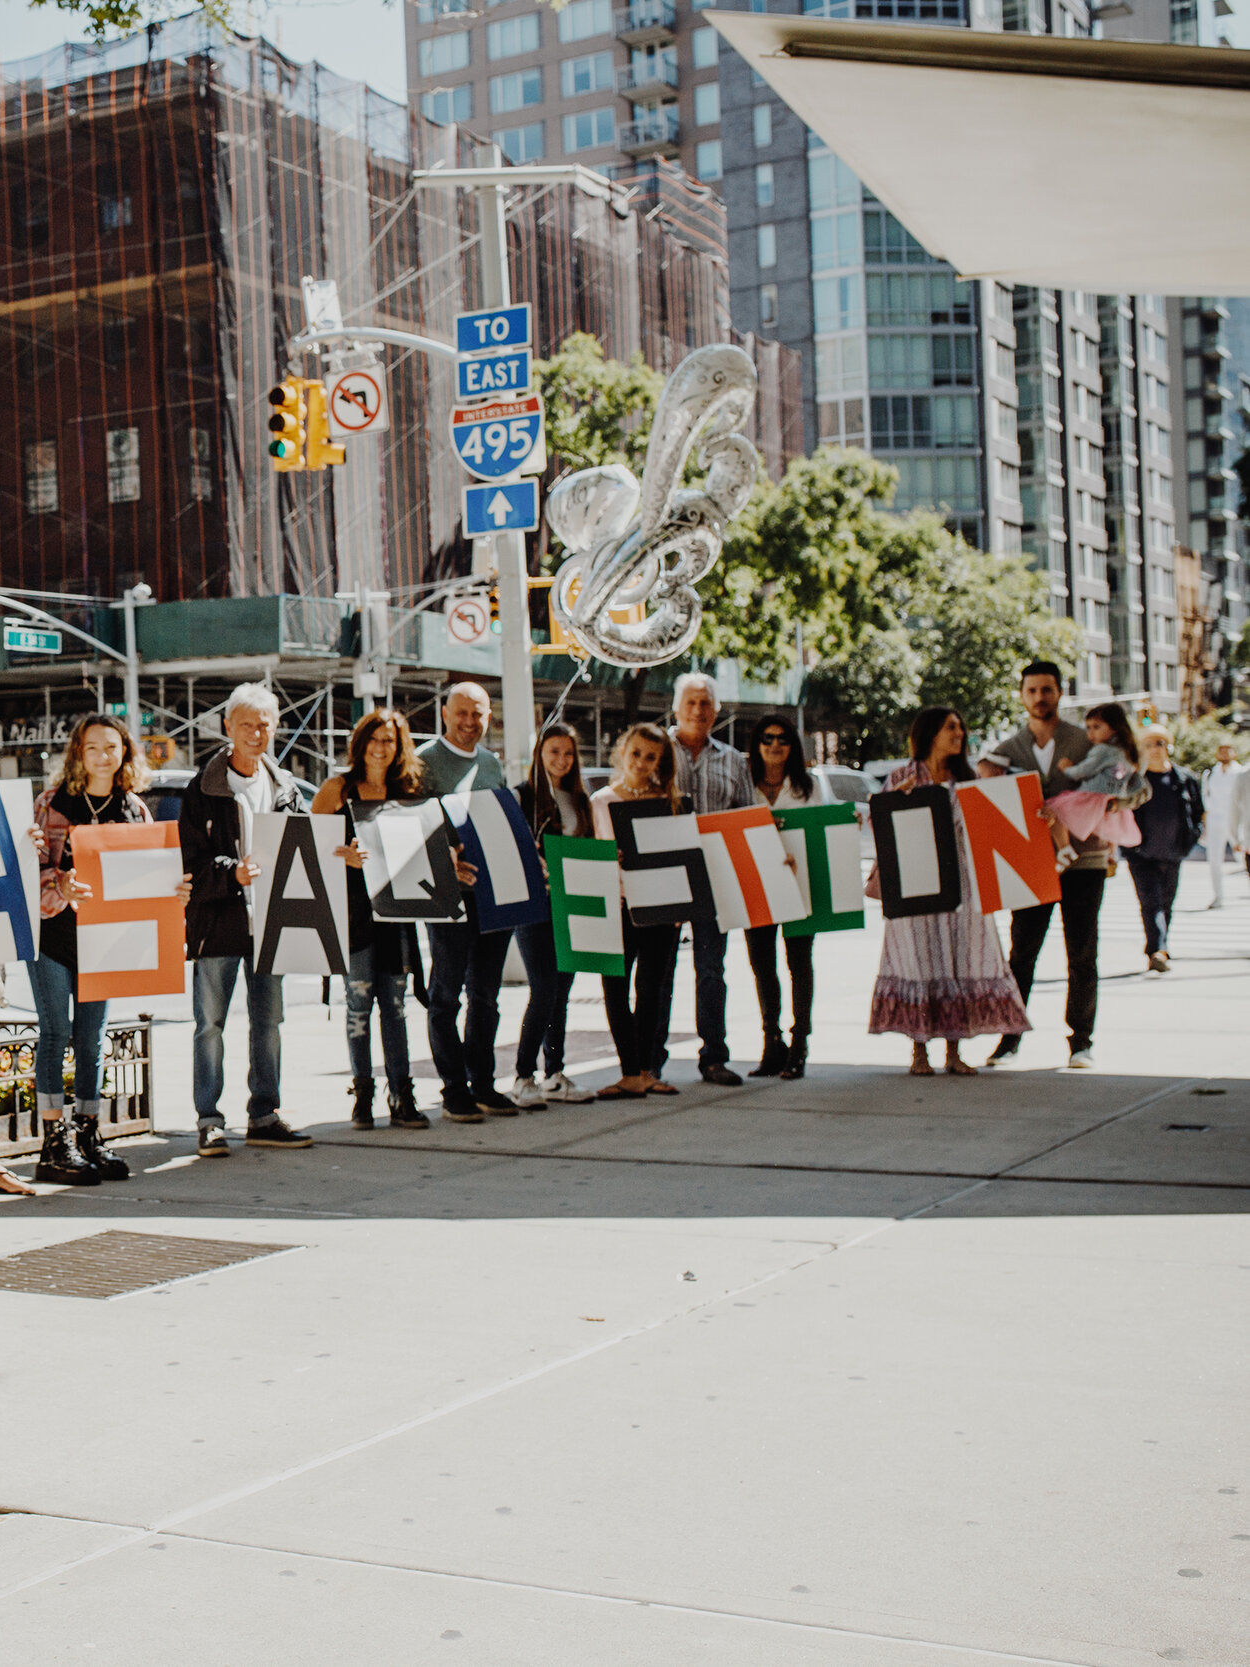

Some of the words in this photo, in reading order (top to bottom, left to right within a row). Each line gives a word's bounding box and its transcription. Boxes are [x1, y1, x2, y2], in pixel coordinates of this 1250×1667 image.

[473, 316, 510, 344] TO
[466, 360, 520, 392] EAST
[463, 403, 528, 421] INTERSTATE
[462, 420, 533, 464] 495
[256, 815, 348, 974] A
